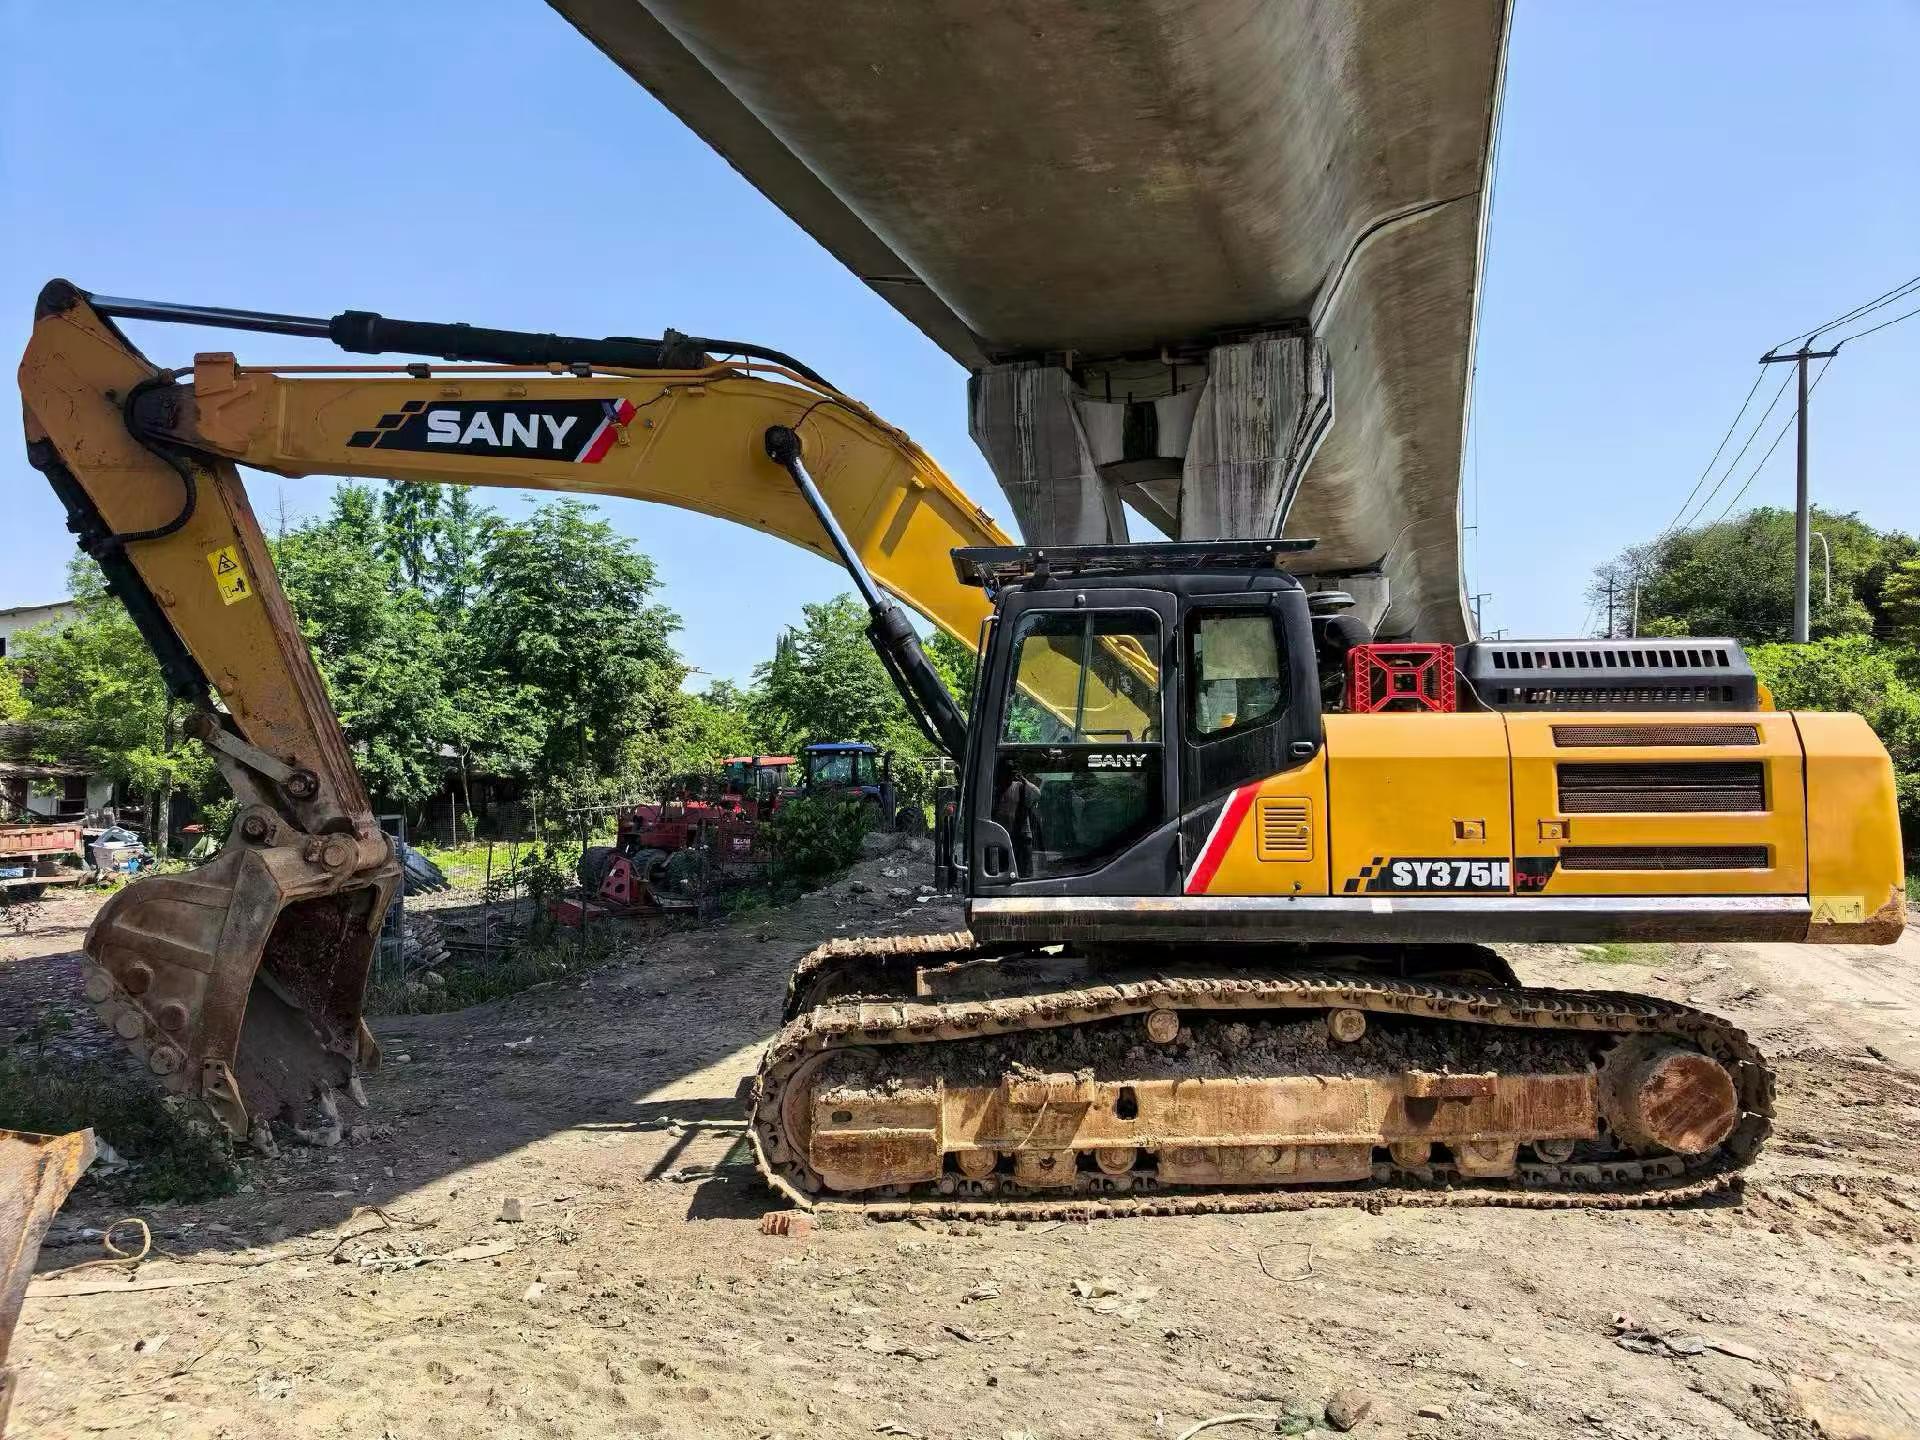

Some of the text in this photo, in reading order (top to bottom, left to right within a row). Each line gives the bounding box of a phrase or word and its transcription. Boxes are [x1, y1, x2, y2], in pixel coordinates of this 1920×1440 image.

[426, 409, 578, 450] SANY
[1087, 753, 1148, 768] SANY
[1392, 861, 1547, 888] SY375H Pro
